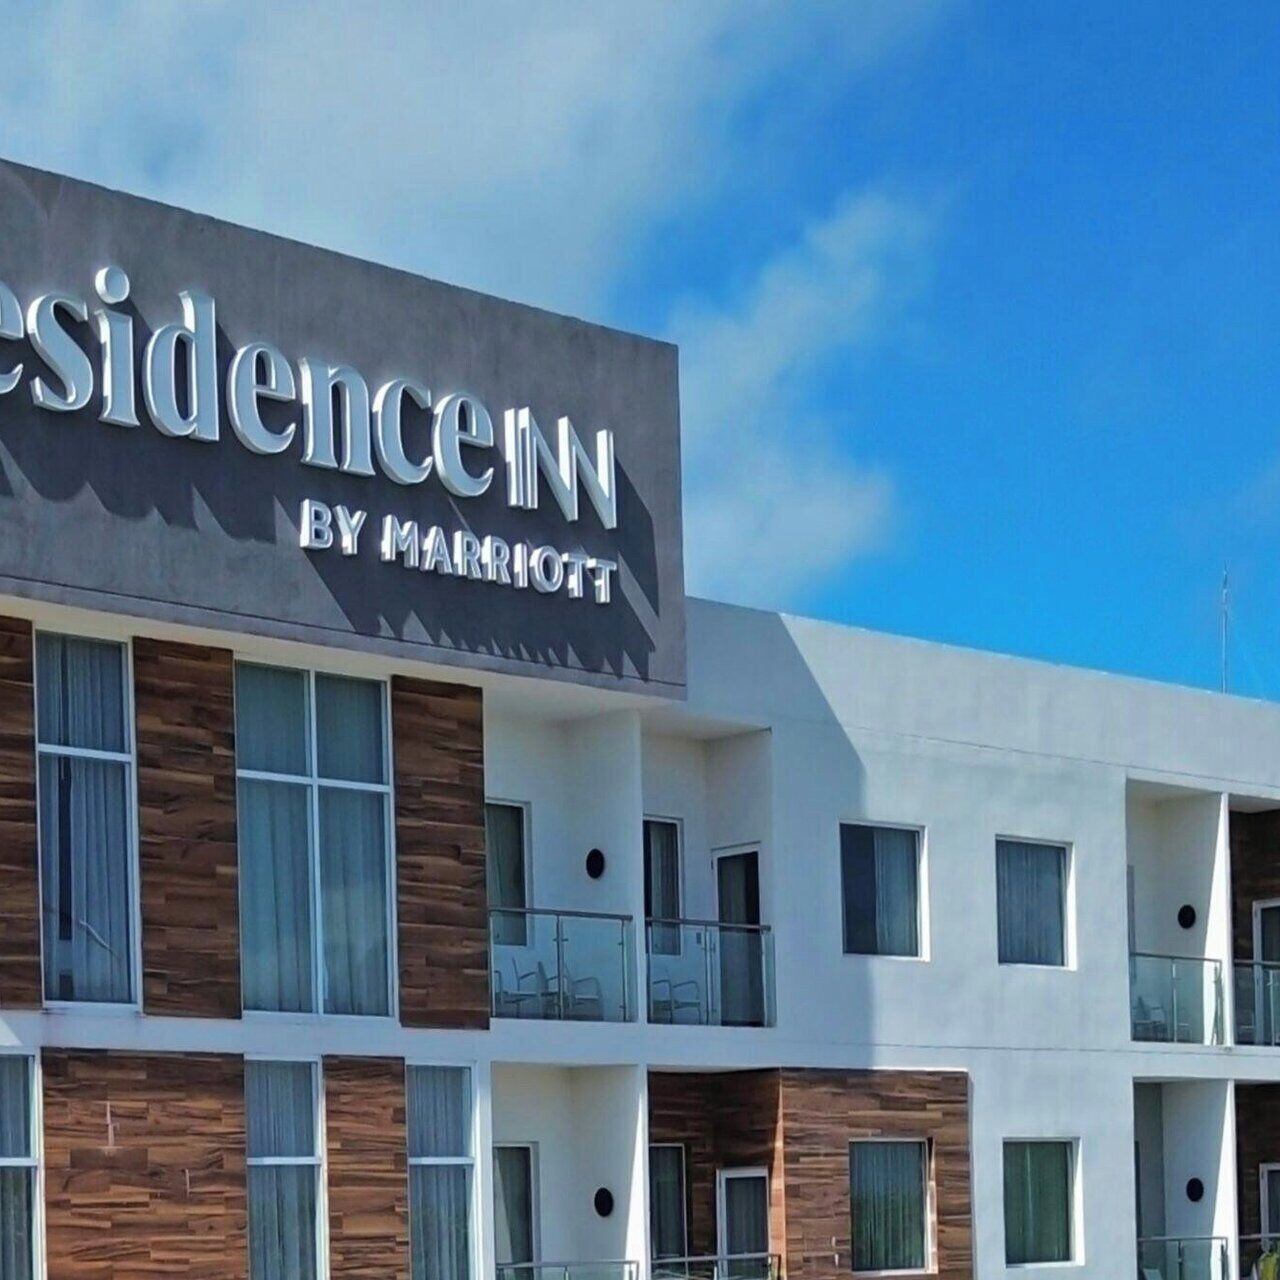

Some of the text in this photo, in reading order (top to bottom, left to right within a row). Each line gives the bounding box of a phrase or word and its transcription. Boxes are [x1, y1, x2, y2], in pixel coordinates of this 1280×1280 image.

[504, 406, 617, 530] INN
[300, 498, 617, 604] BY MARRIOTT
